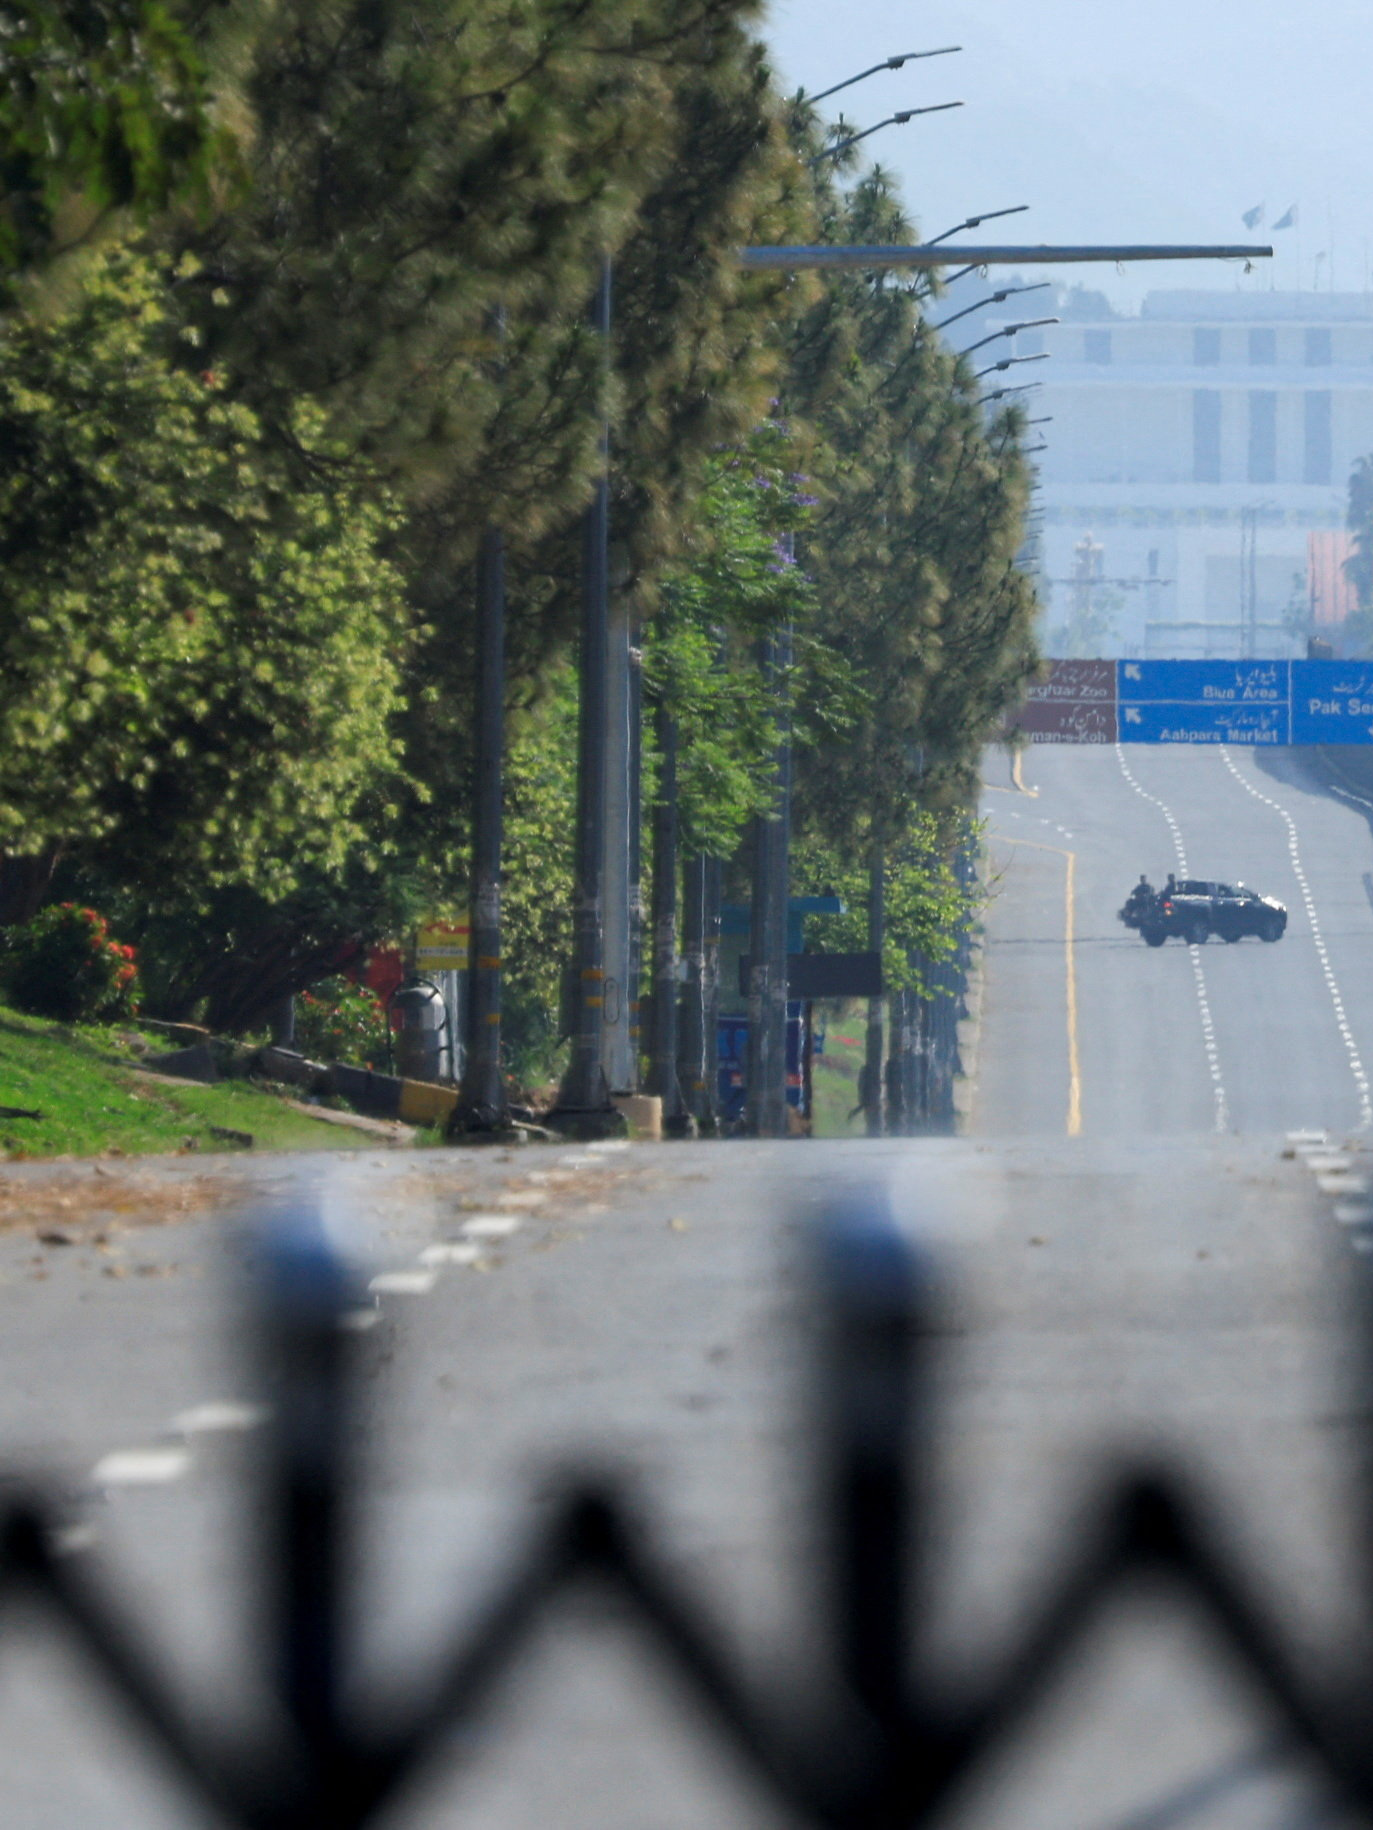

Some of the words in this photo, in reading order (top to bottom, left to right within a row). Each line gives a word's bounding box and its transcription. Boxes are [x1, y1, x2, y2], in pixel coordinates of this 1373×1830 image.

[1080, 684, 1108, 697] Zoo
[1203, 685, 1235, 699] Blue
[1243, 685, 1278, 699] Area
[1308, 699, 1341, 715] Pak
[1159, 728, 1221, 742] Aabpara
[1227, 728, 1278, 743] Market
